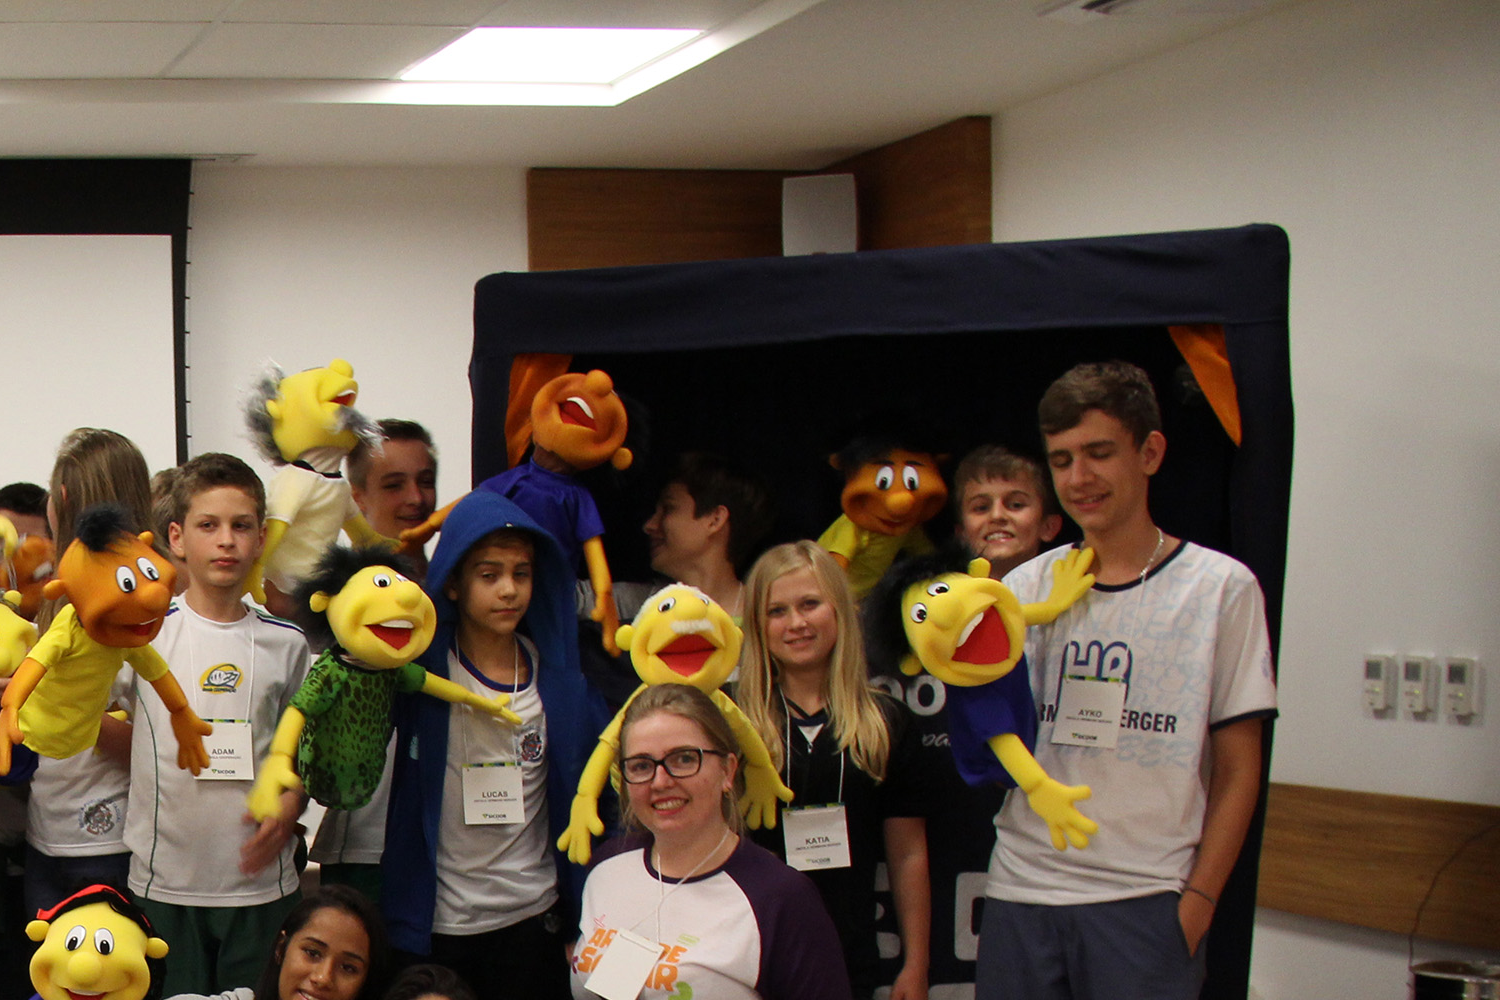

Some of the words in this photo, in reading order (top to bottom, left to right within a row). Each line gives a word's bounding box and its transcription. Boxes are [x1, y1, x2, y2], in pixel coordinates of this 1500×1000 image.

[1078, 708, 1103, 718] AYKO
[1120, 708, 1178, 733] ERGER
[805, 836, 830, 845] KATIA
